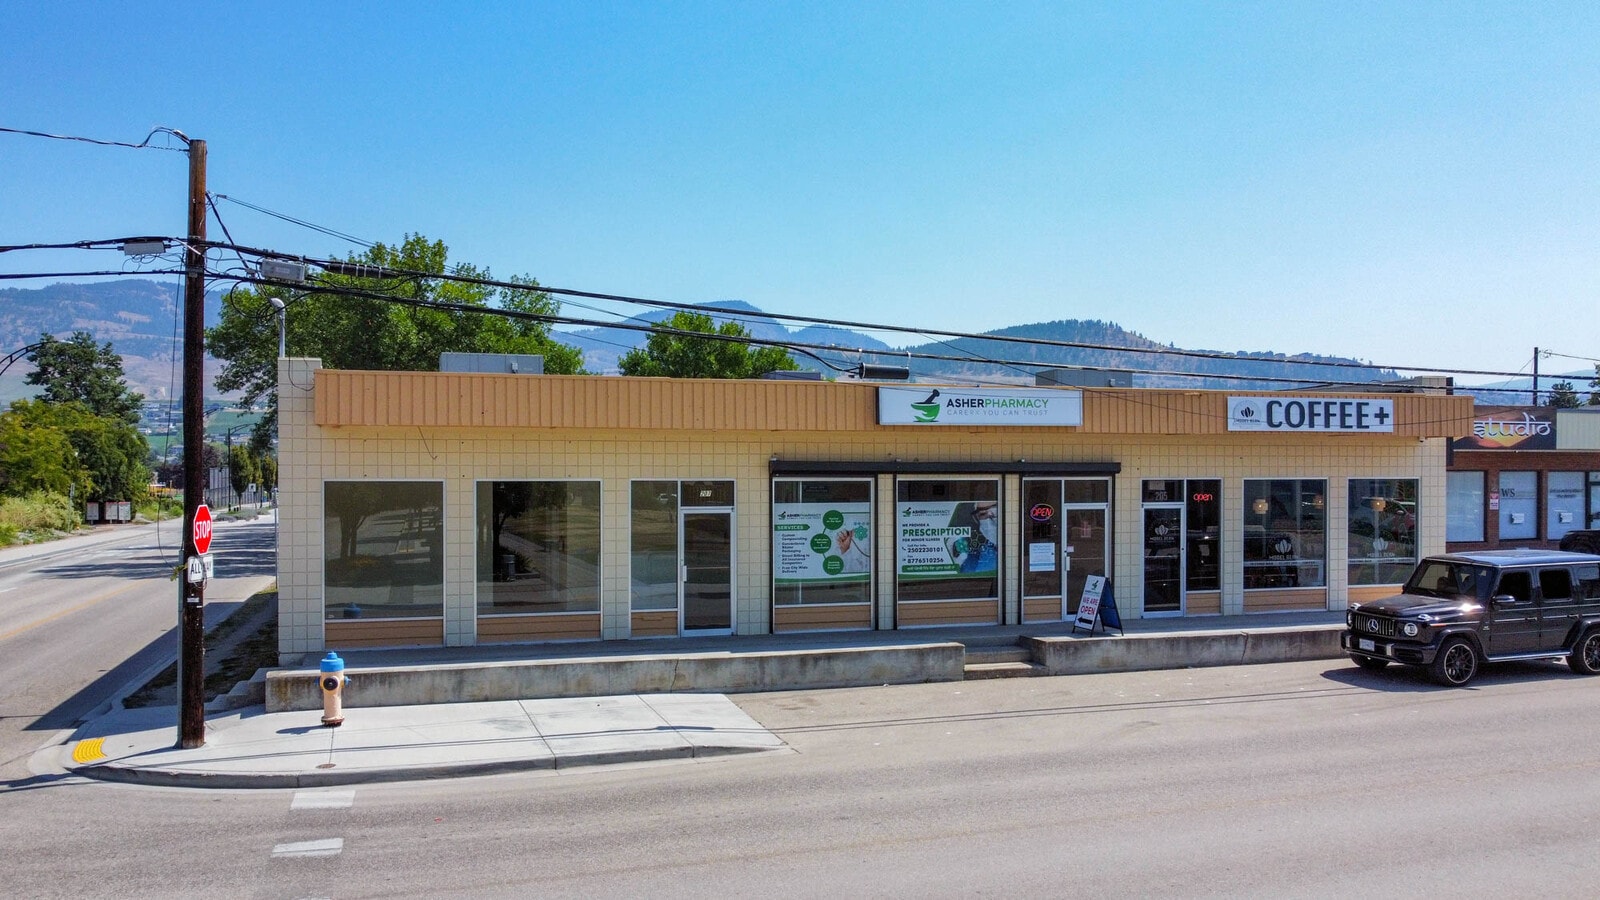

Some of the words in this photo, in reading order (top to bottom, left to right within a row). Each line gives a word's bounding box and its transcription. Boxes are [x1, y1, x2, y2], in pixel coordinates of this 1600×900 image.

[947, 398, 1049, 408] ASHERPHARMACY
[1266, 400, 1389, 429] COFFEE+
[1193, 493, 1213, 502] open
[1032, 508, 1052, 516] OPEN
[195, 521, 211, 539] STOP
[902, 528, 970, 536] PRESCRIPTION
[190, 563, 202, 574] ALL
[1080, 605, 1096, 616] OPEN
